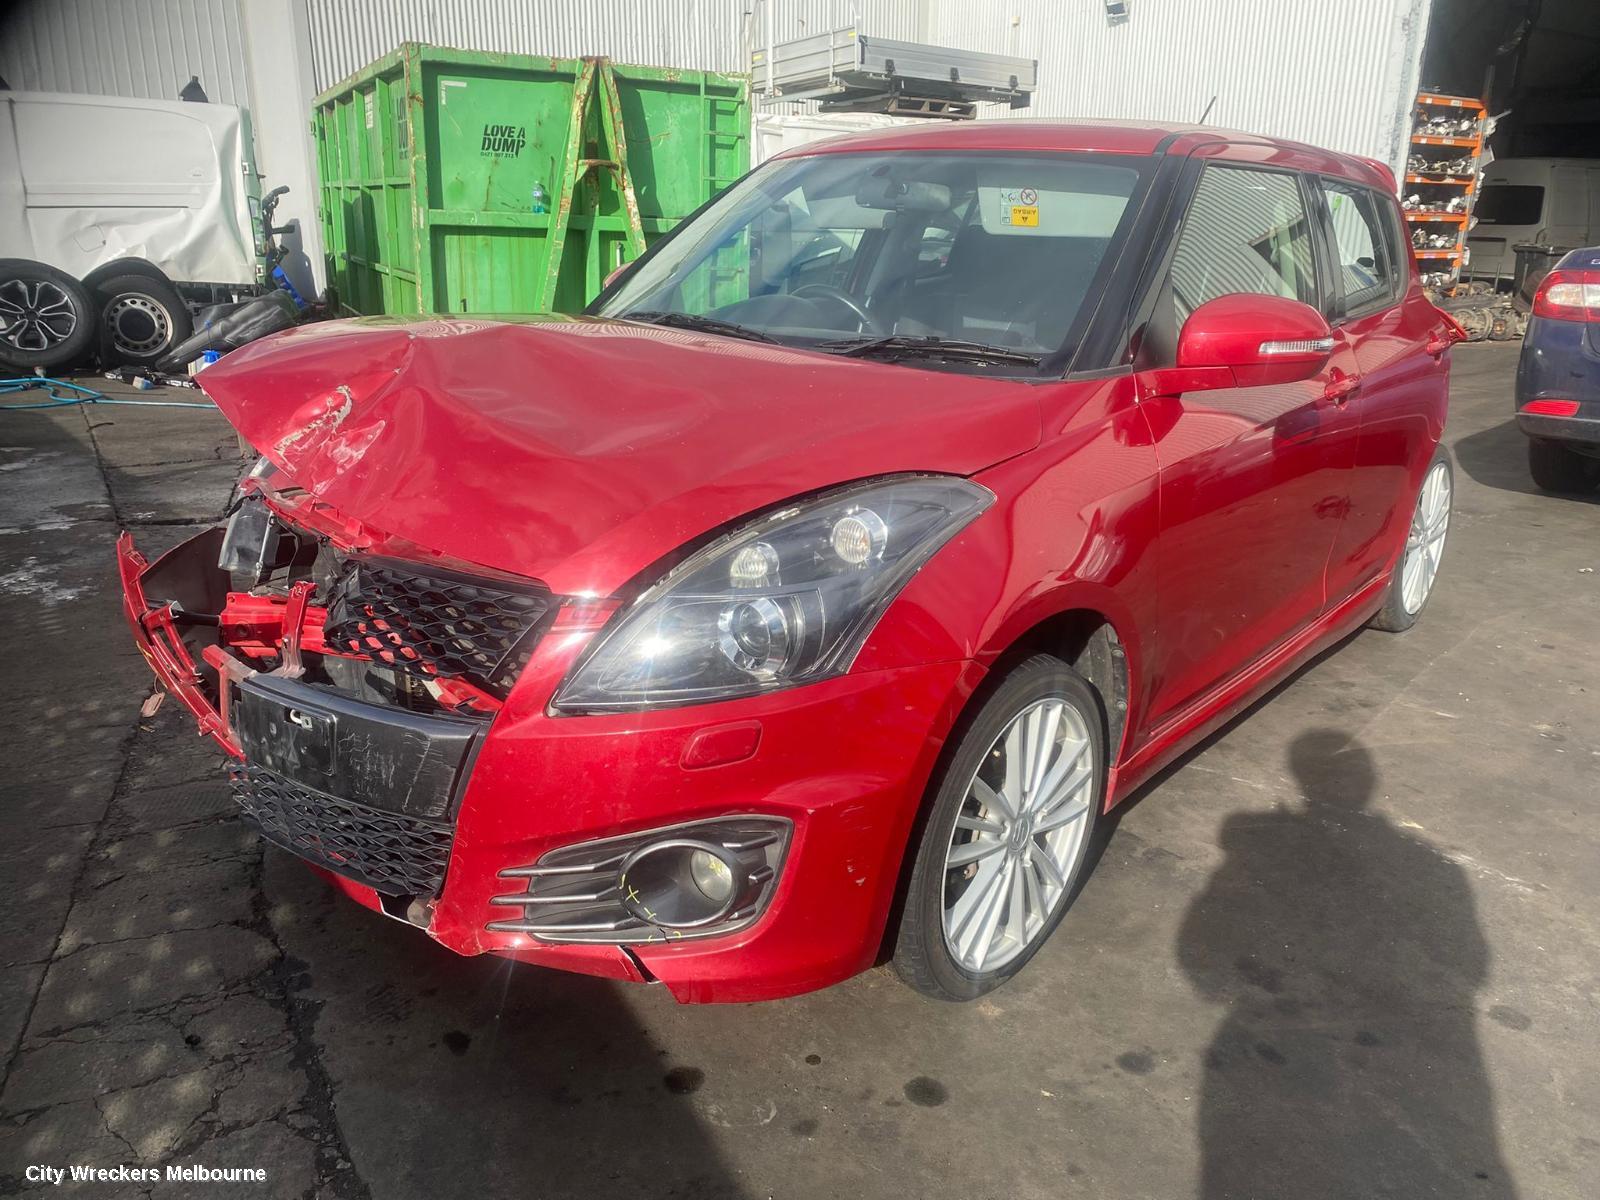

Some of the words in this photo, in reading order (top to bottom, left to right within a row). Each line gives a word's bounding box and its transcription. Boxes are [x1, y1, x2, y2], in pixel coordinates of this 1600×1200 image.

[483, 124, 516, 138] LOVE
[517, 126, 526, 139] A
[481, 136, 526, 158] DUMP
